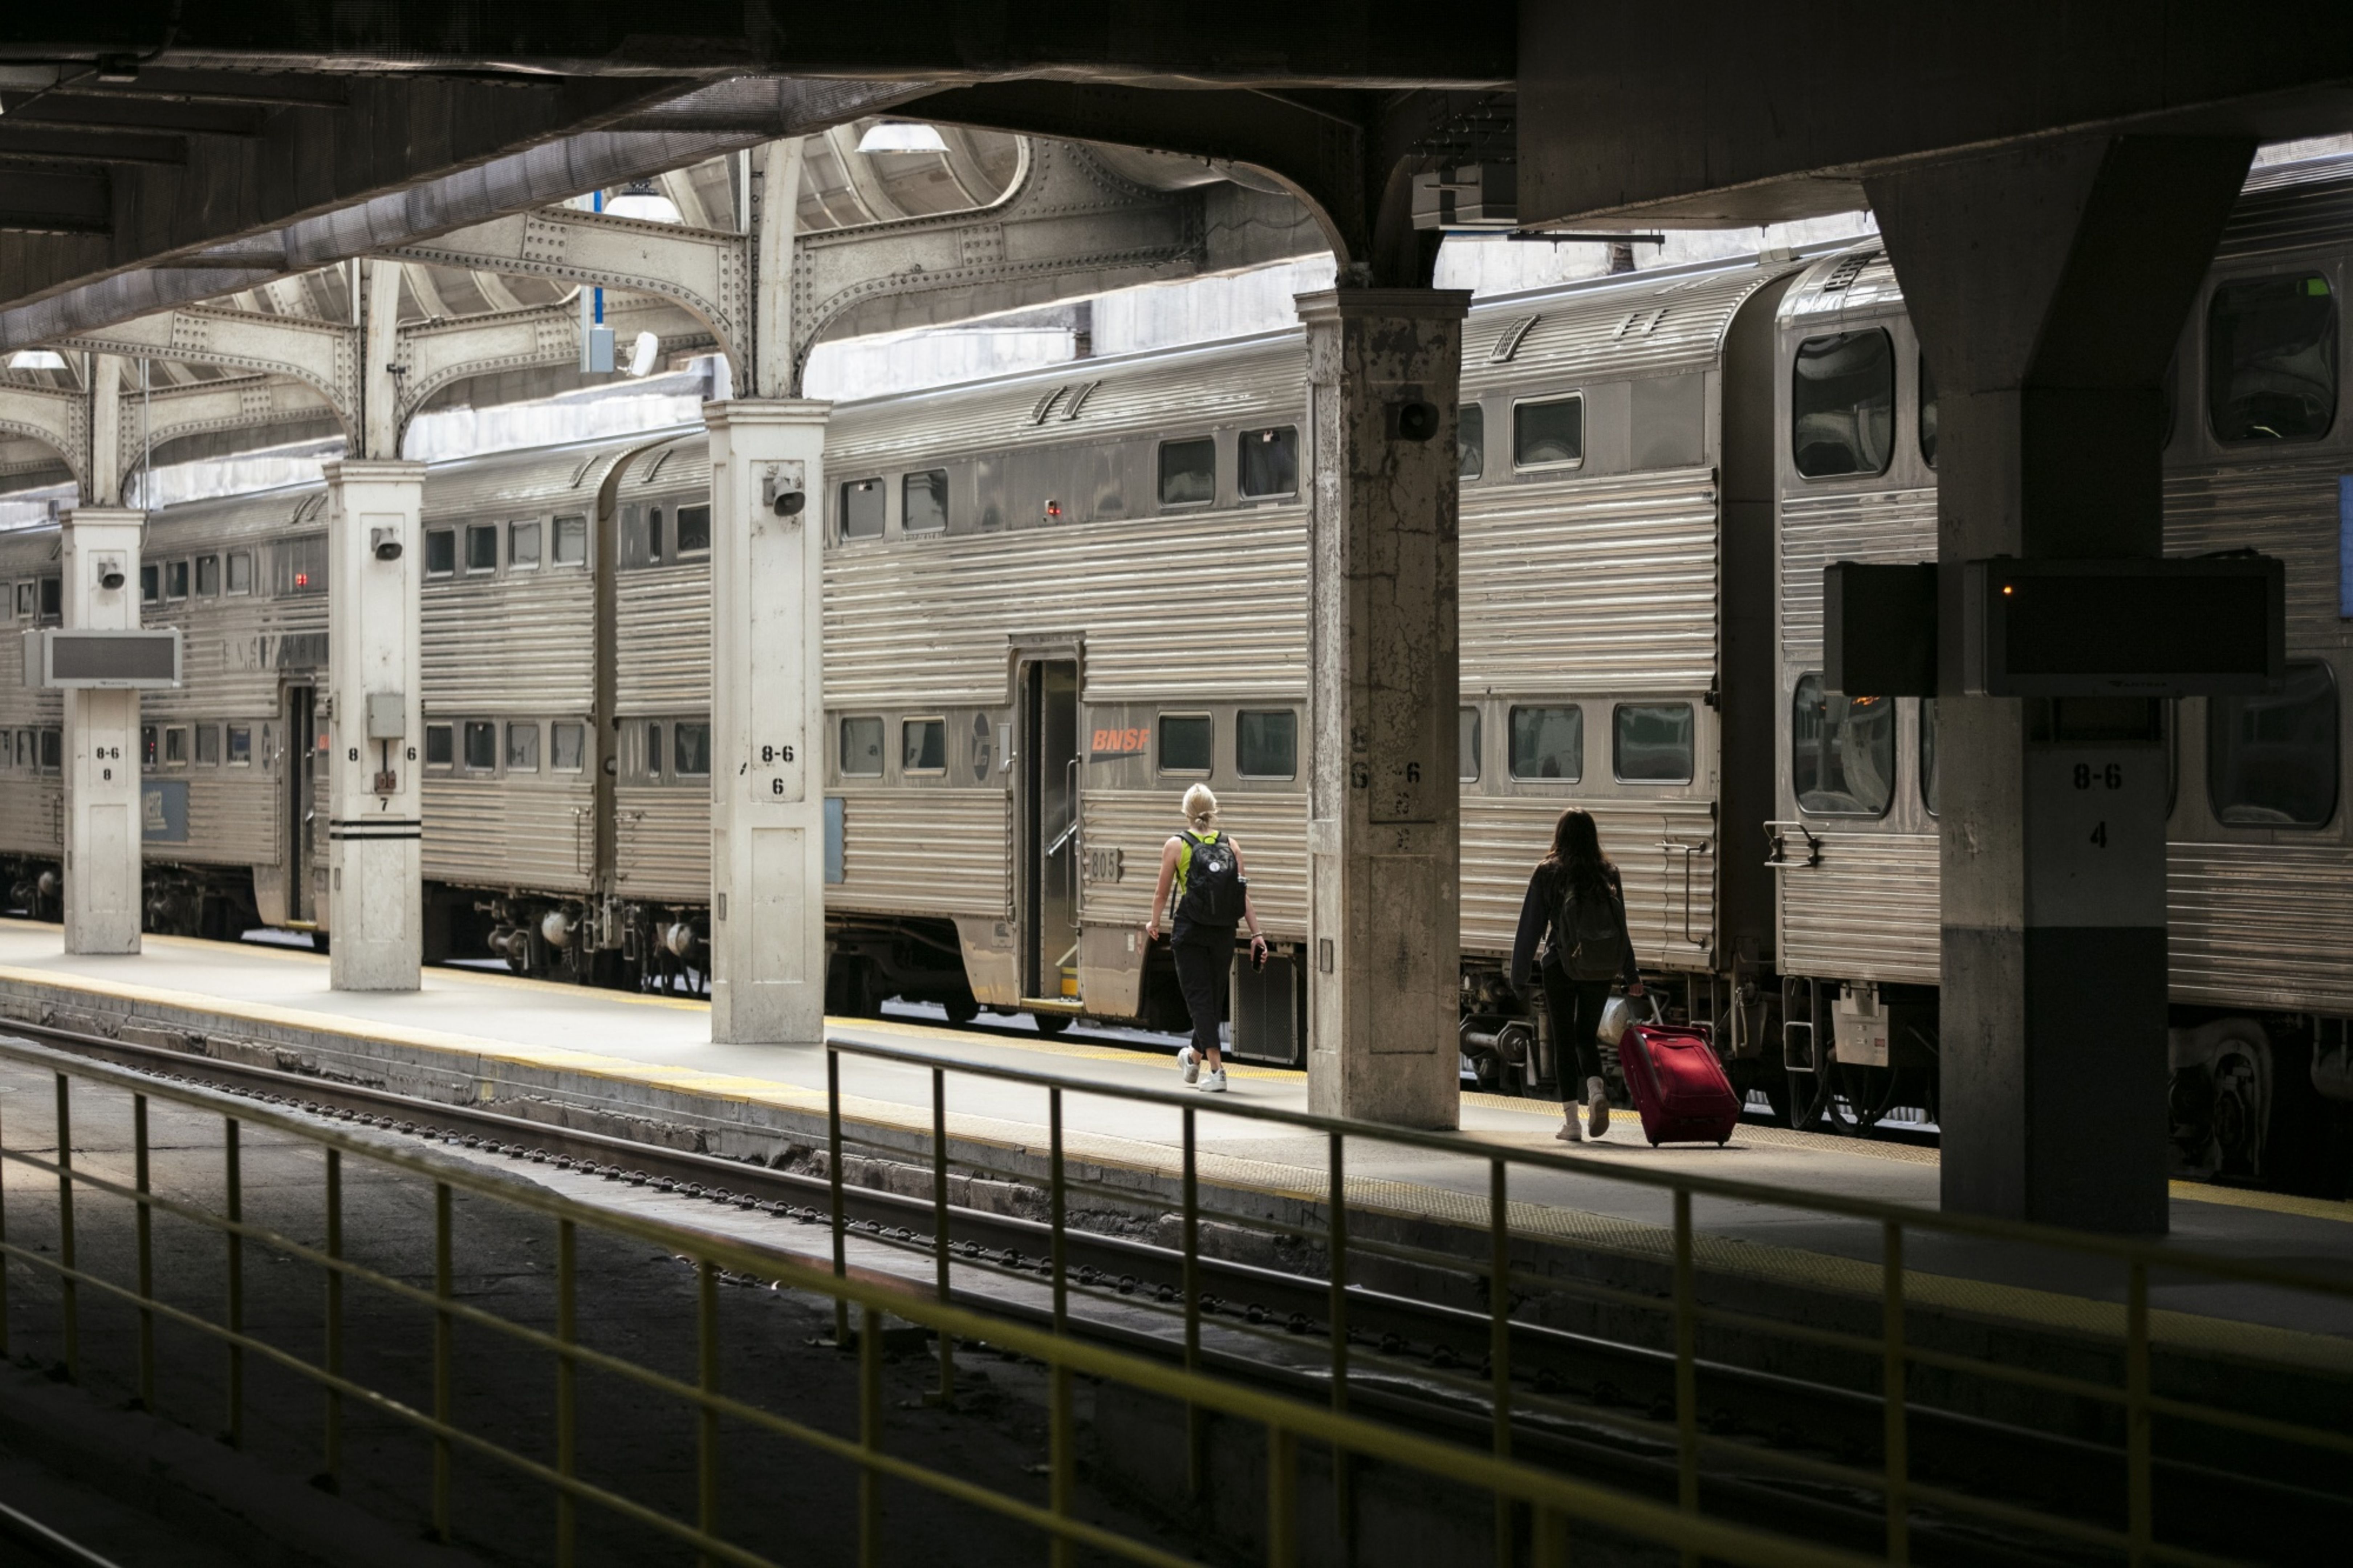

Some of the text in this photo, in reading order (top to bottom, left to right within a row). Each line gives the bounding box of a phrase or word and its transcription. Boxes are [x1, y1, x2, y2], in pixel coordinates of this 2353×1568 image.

[1092, 728, 1150, 751] BNSF
[97, 747, 119, 760] 8-6
[349, 747, 416, 761] 8 6
[762, 745, 794, 763] 8-6
[103, 769, 111, 780] 8
[2074, 763, 2121, 789] 8-6
[772, 778, 784, 795] 6
[380, 797, 389, 812] 7
[2090, 821, 2106, 848] 4
[1093, 852, 1114, 878] 805
